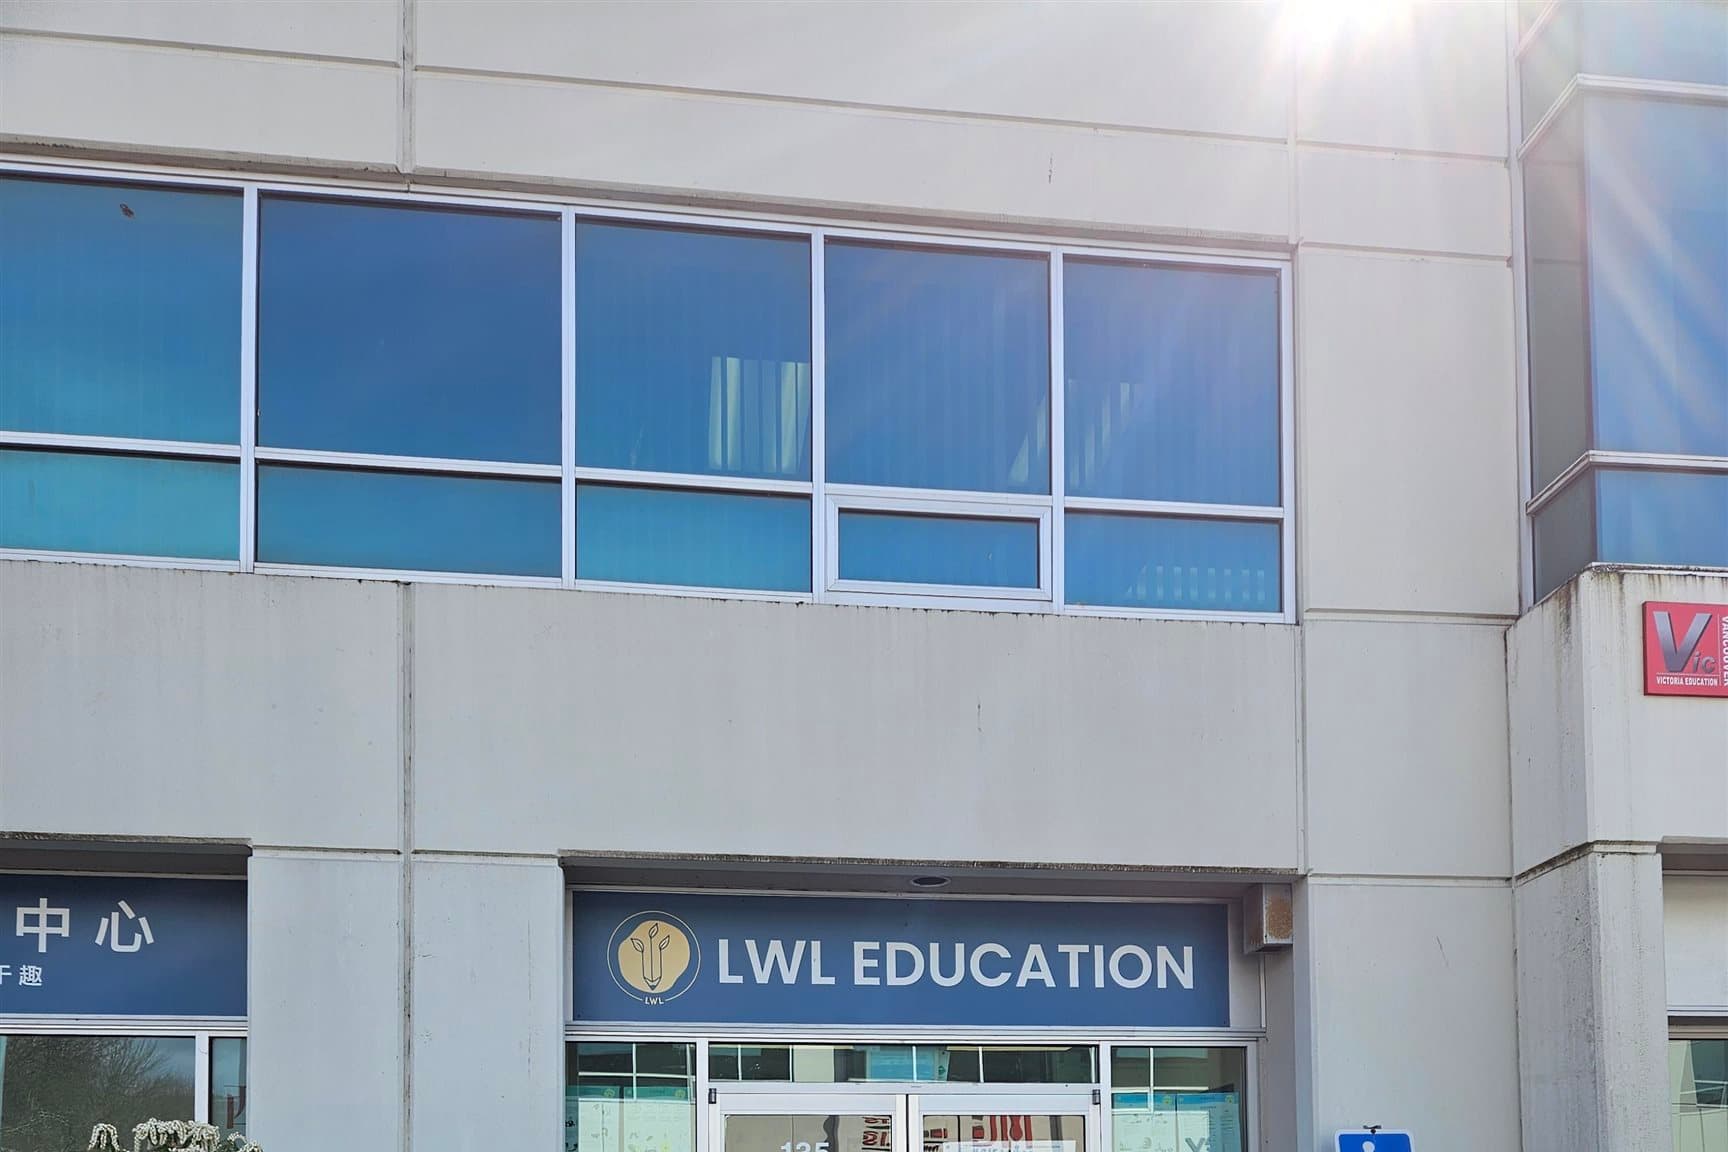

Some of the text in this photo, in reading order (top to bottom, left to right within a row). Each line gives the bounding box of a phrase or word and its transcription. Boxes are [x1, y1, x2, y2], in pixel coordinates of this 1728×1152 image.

[1656, 675, 1718, 687] VICTORIA EDUCATION
[16, 897, 154, 953] 中心
[718, 938, 1194, 989] LWL EDUCATION
[645, 996, 664, 1005] LWL
